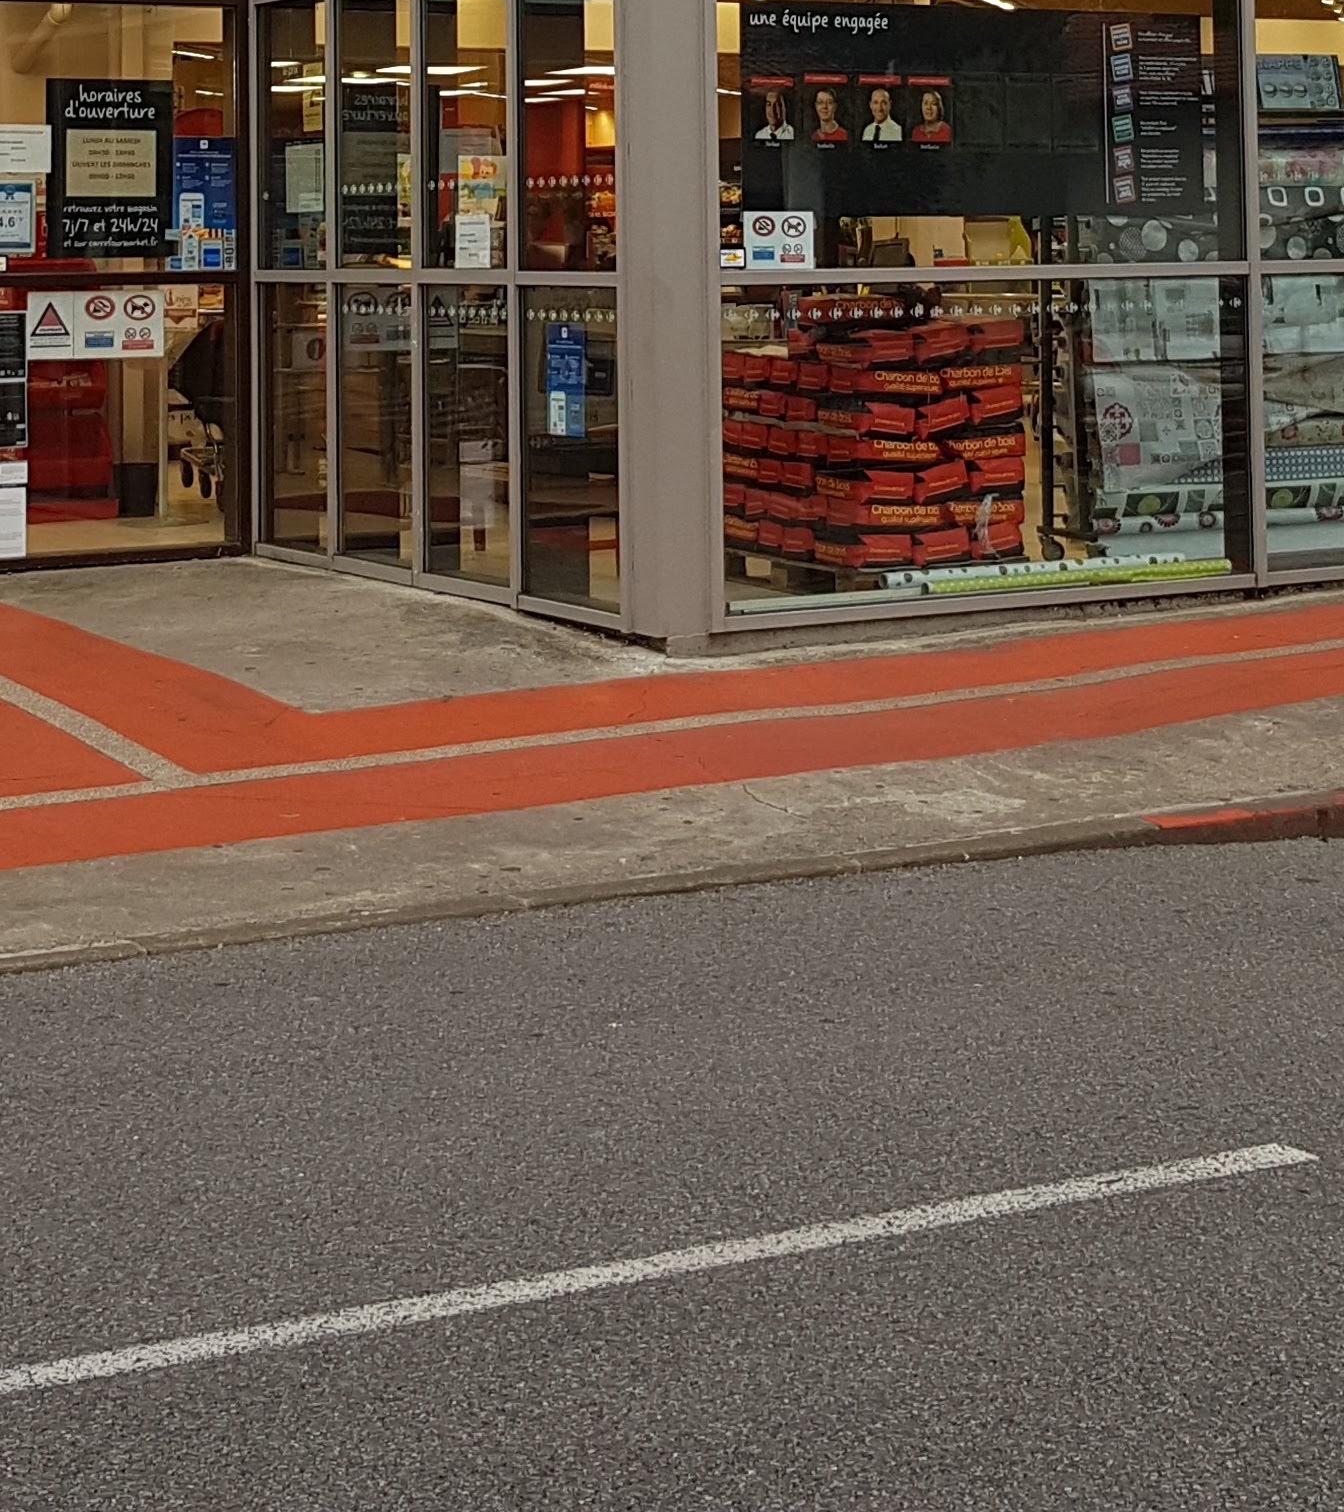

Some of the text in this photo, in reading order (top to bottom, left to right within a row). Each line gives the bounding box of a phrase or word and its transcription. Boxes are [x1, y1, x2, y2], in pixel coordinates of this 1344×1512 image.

[749, 9, 889, 35] une équipe engagée
[79, 84, 142, 103] horaires
[65, 100, 156, 119] d'ouverture
[62, 217, 159, 237] 7j/7 et 24h/24
[874, 370, 941, 384] Charbon de bo
[940, 367, 982, 379] Charbon
[982, 365, 994, 377] de
[873, 439, 914, 451] Charbon
[915, 440, 928, 451] de
[983, 437, 997, 449] de
[997, 436, 1016, 447] bois
[871, 504, 913, 515] Charbon
[913, 505, 926, 515] de
